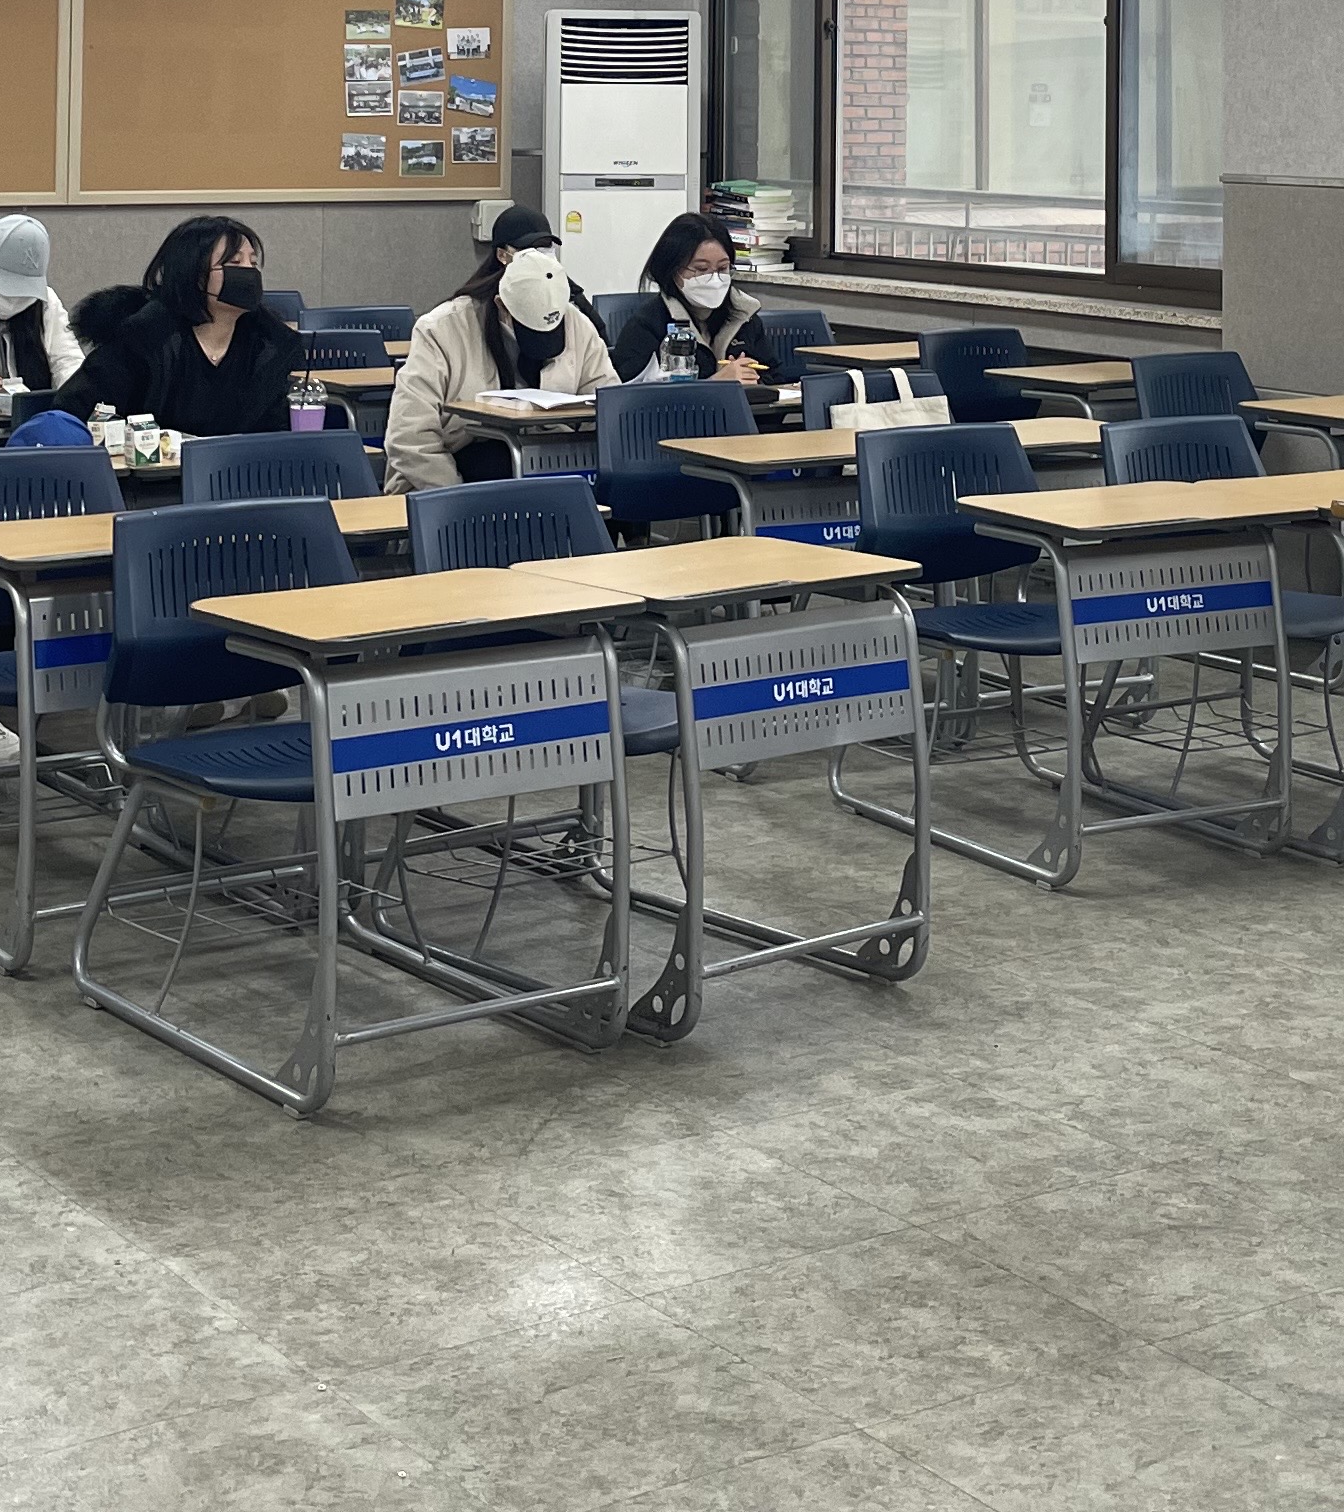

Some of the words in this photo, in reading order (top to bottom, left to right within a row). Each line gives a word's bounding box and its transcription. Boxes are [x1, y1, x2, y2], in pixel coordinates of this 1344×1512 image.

[1146, 593, 1204, 613] U1대학교
[773, 676, 835, 701] U1대학교
[435, 722, 515, 751] U1대학교
